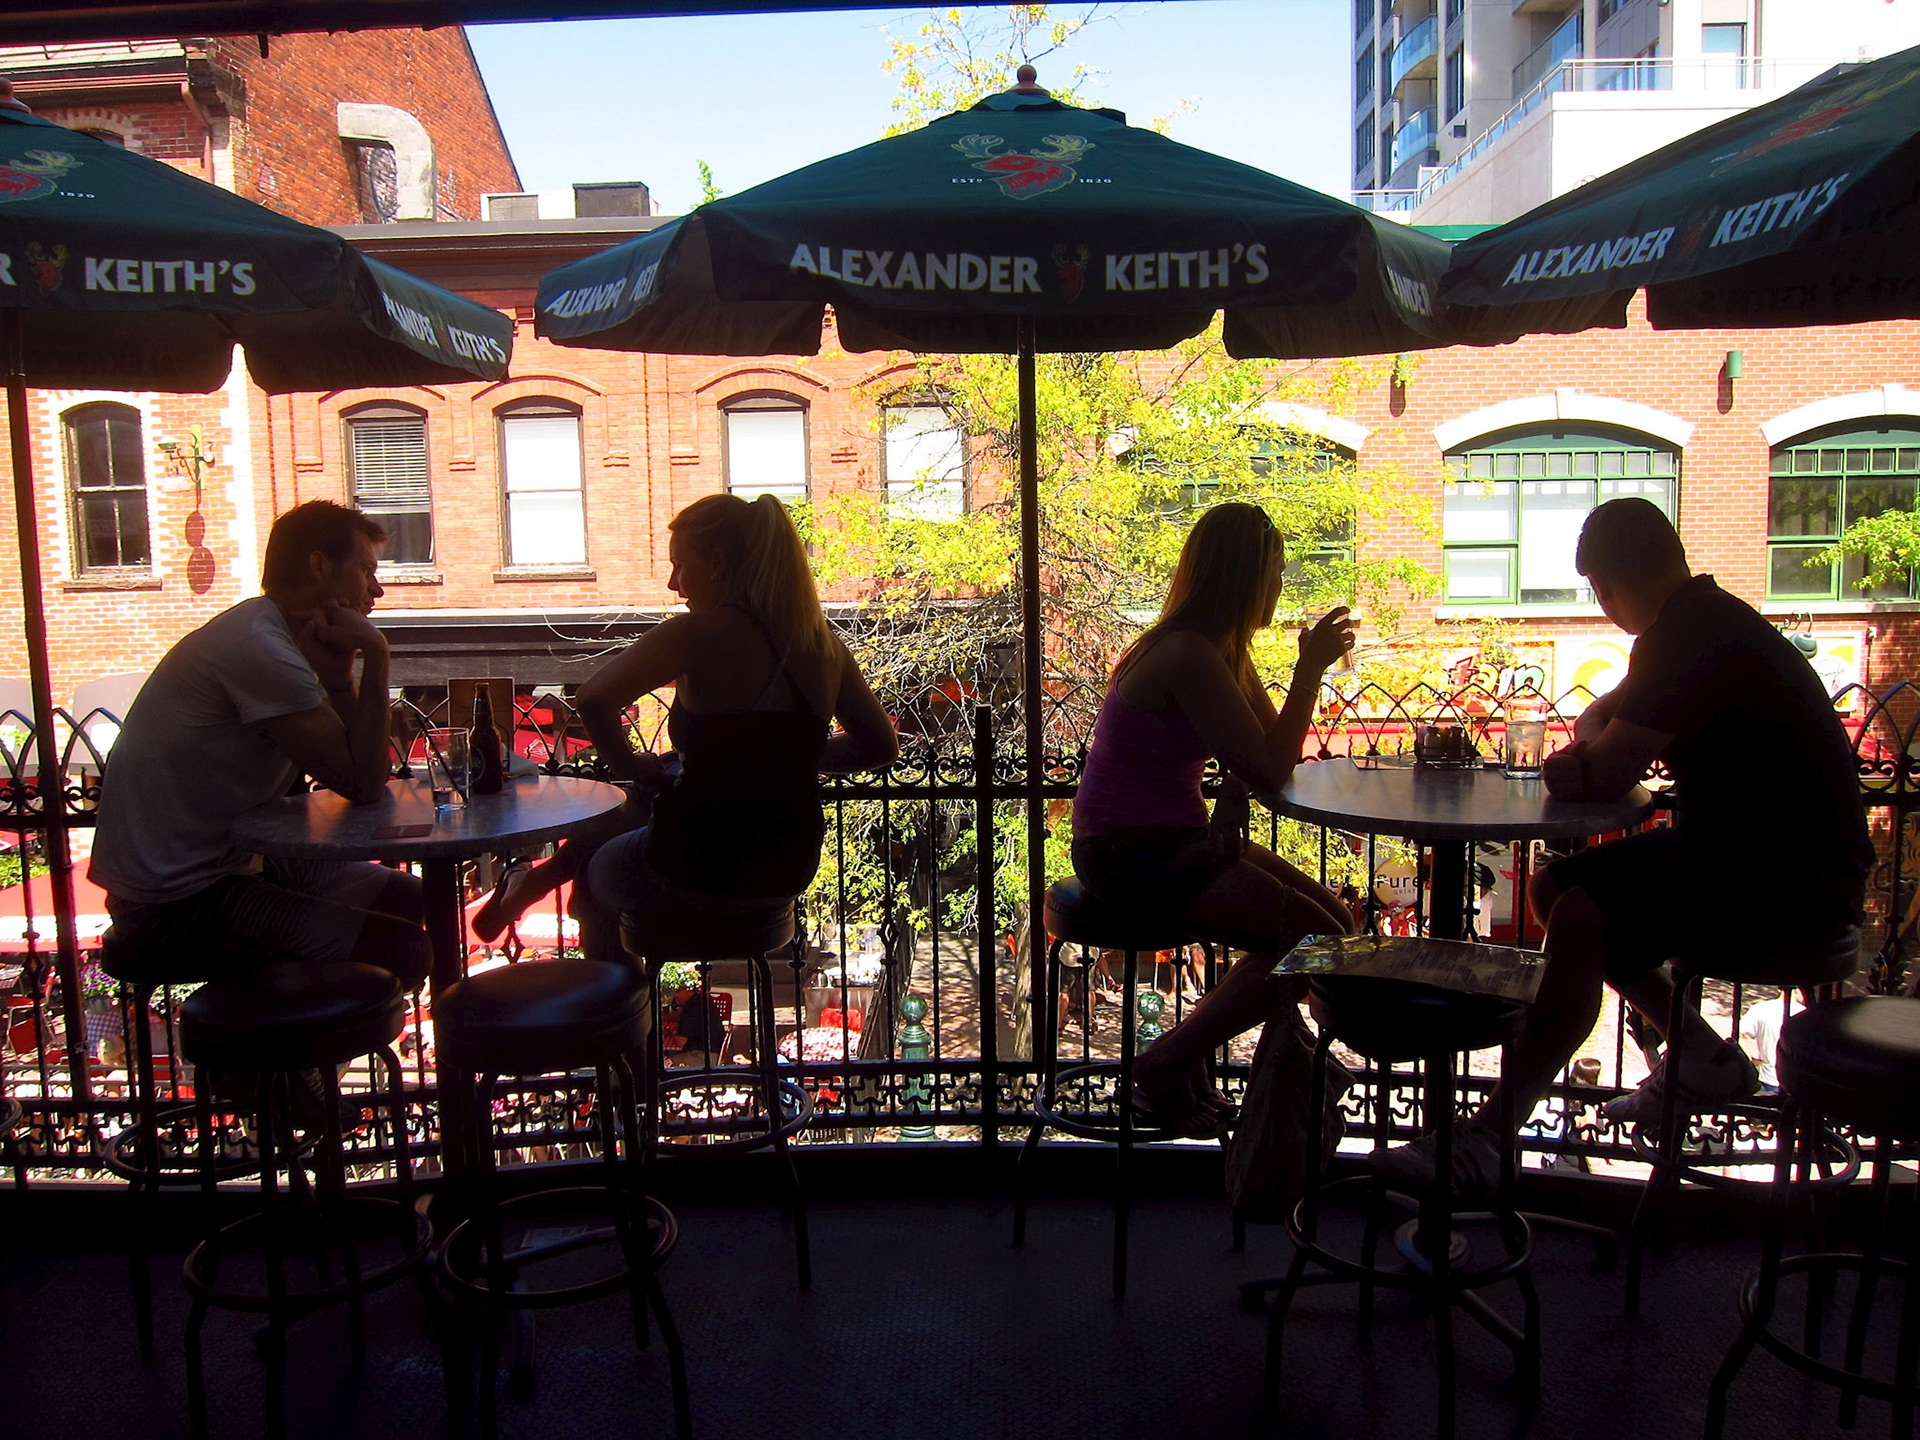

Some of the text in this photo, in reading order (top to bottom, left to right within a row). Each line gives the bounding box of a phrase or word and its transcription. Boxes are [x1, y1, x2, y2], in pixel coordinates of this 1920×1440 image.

[1501, 173, 1850, 287] ALEXANDER KEITH'S
[84, 256, 257, 296] KEITH'S
[788, 242, 1270, 293] ALEXANDER KEITH'S
